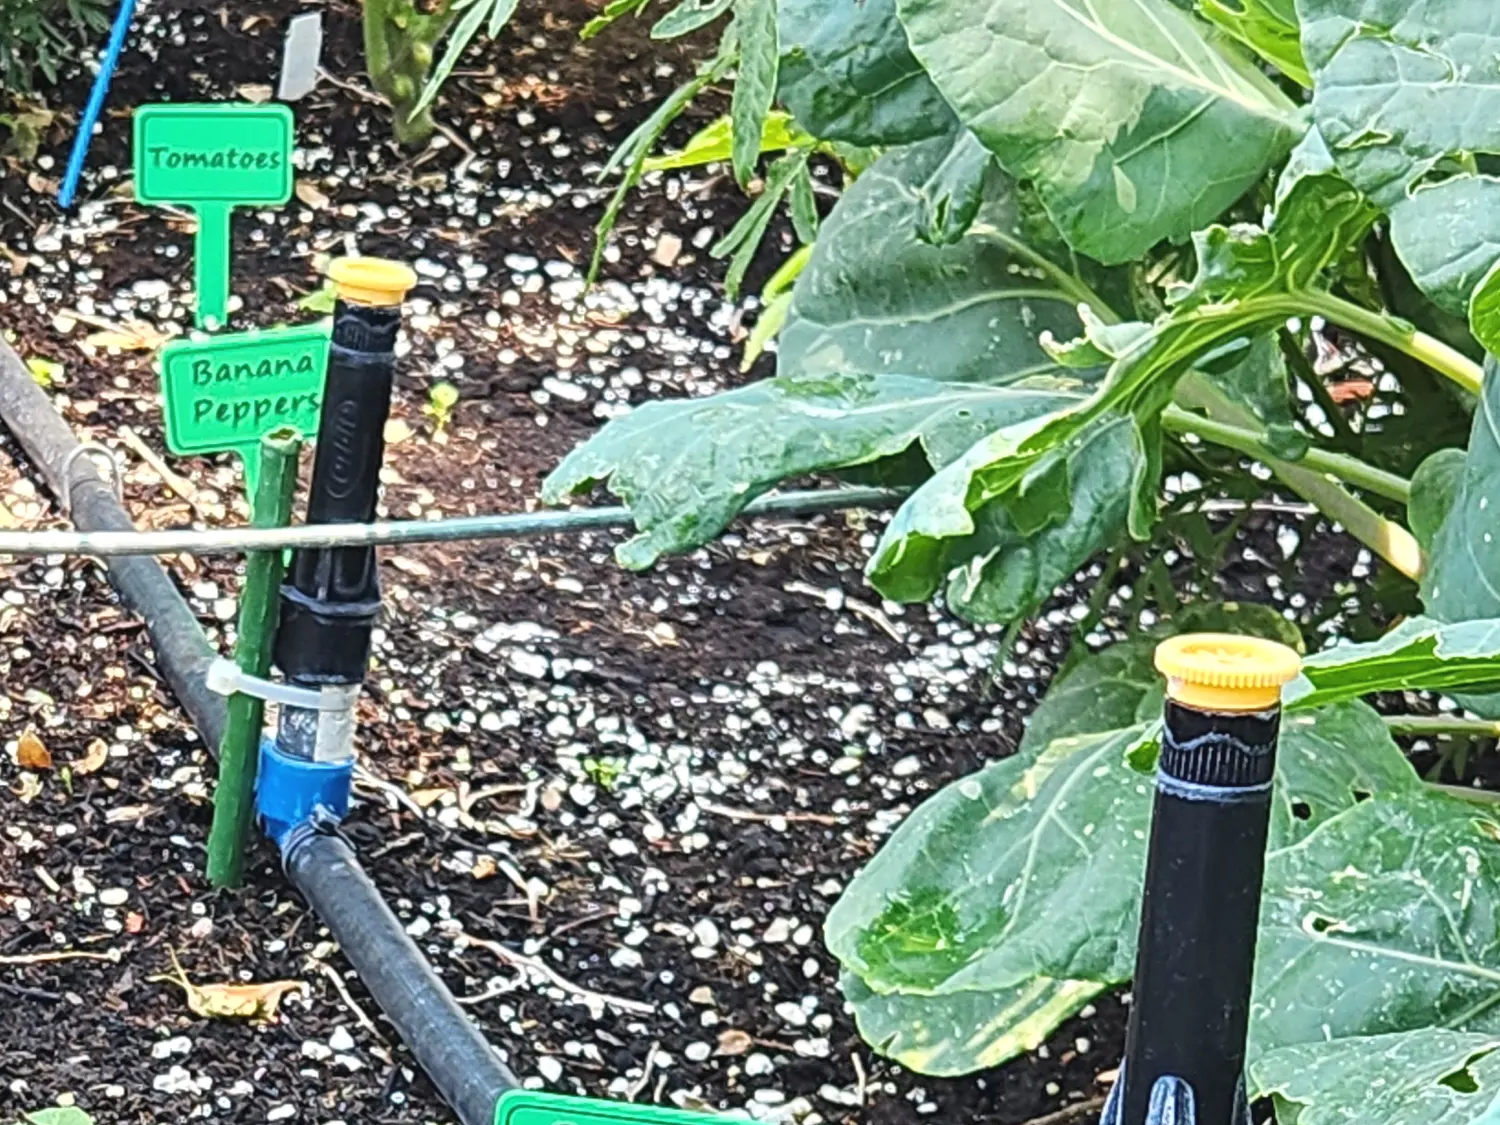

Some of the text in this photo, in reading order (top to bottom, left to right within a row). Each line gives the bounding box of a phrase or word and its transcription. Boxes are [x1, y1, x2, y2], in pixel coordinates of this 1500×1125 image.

[148, 143, 281, 170] Tomatoes
[191, 355, 314, 387] Banana
[193, 392, 320, 429] Peppers
